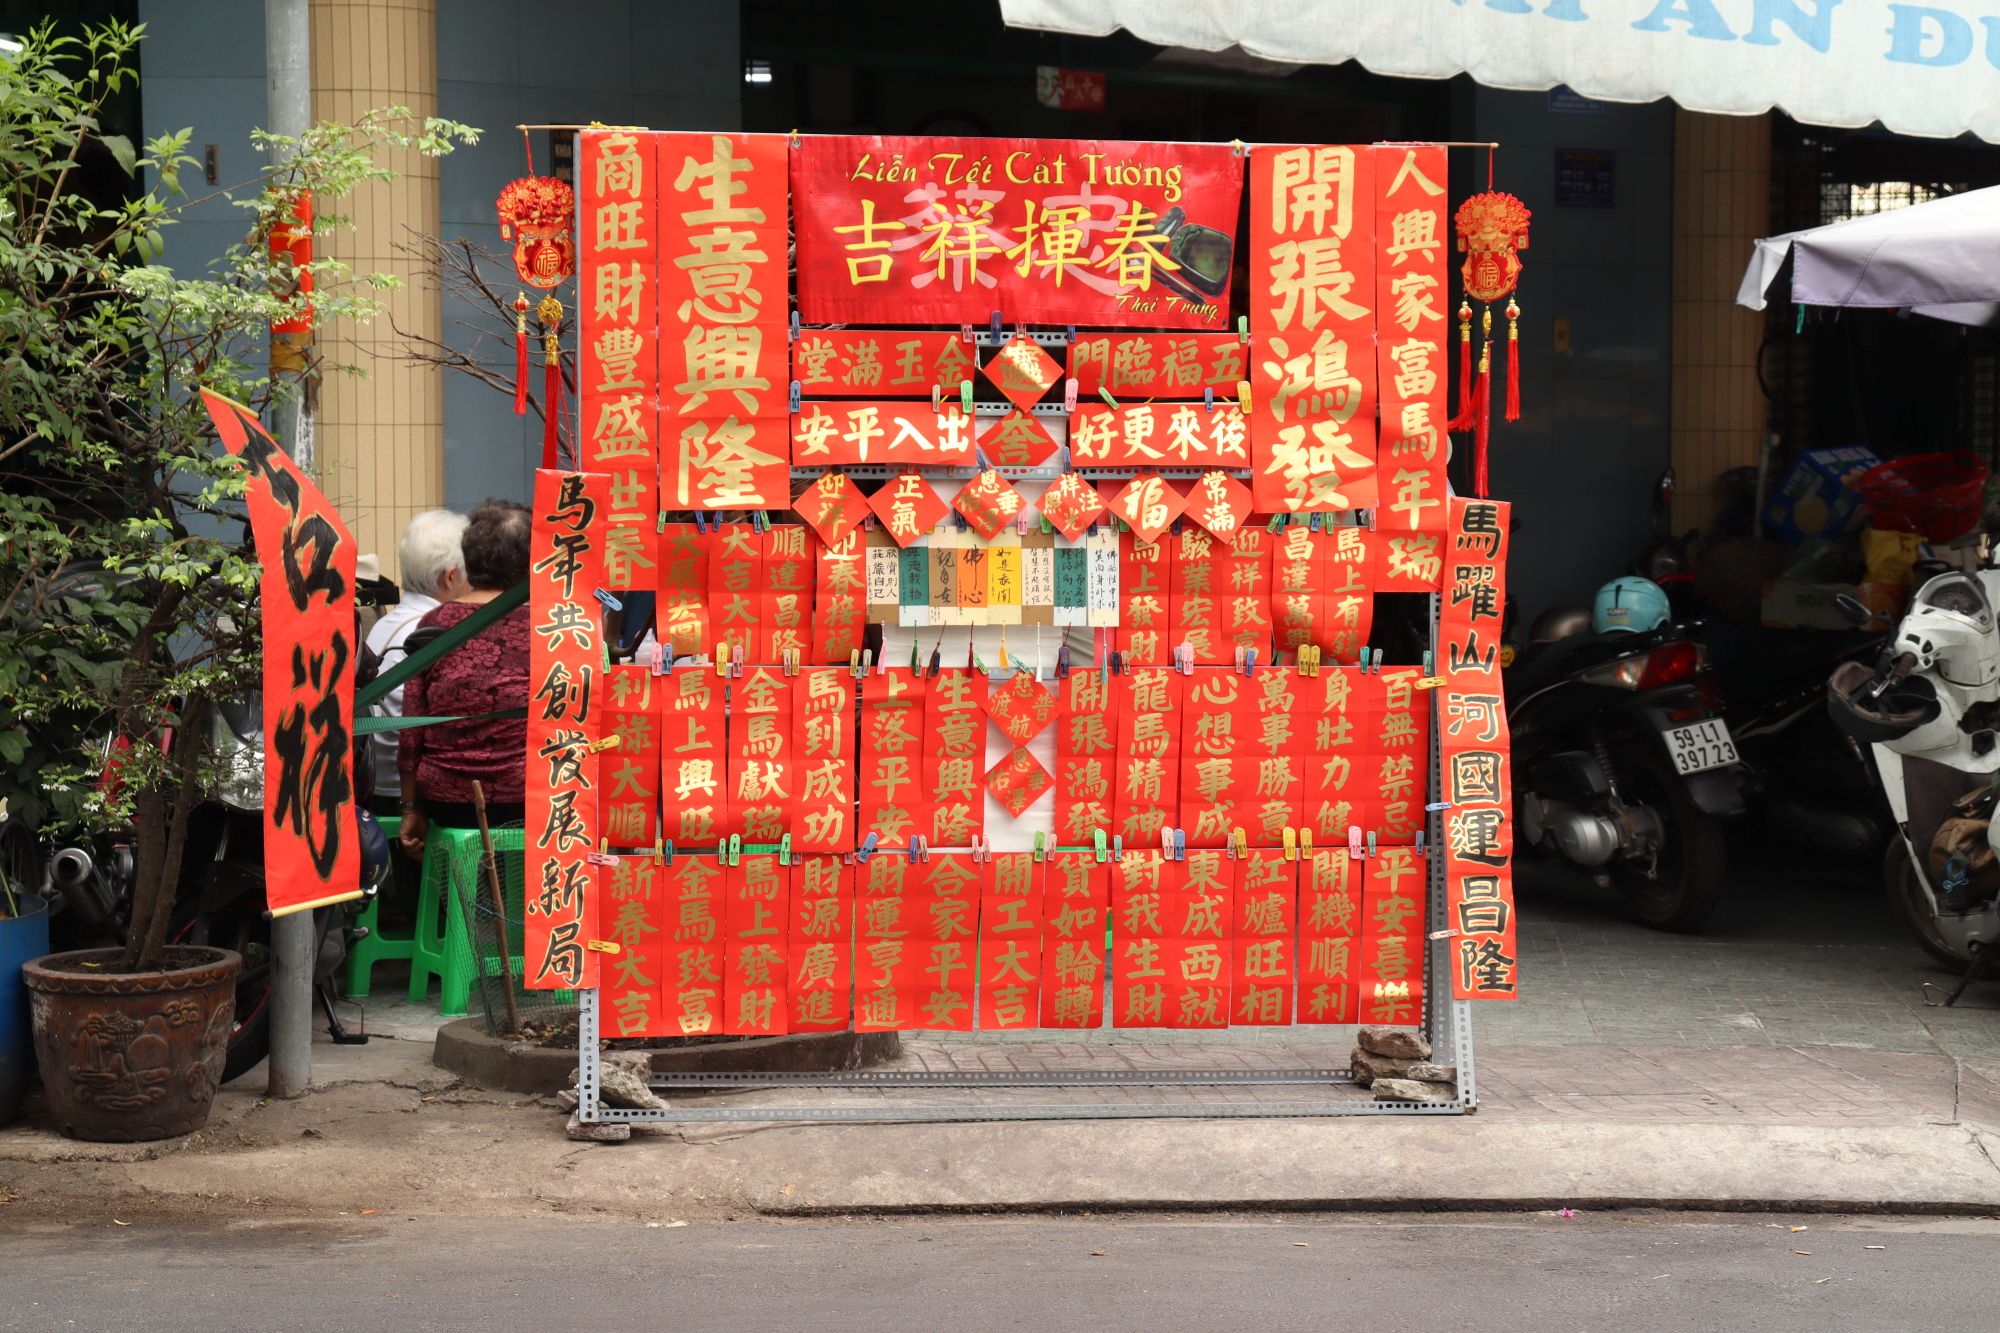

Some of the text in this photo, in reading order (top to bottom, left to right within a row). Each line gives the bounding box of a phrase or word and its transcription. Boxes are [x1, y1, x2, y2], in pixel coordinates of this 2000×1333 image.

[833, 199, 1182, 292] 吉祥揮春
[850, 151, 1184, 203] Liễn Tết Cát Tường
[672, 134, 786, 512] 生意興隆
[1263, 145, 1375, 513] 開張鴻發
[1384, 150, 1447, 582] 人興家富馬年瑞
[890, 474, 924, 537] 正氣
[1123, 476, 1168, 530] 福
[1202, 470, 1236, 532] 常滿
[721, 526, 760, 661] 大吉大利
[1126, 535, 1163, 663] 馬上發財
[606, 669, 653, 842] 利祿大順
[674, 669, 717, 841] 馬上興旺
[738, 668, 790, 841] 金馬獻瑞
[802, 669, 846, 847] 馬到成功
[869, 671, 919, 846] 上落平安
[932, 669, 982, 847] 生意興隆
[1063, 670, 1115, 843] 開張鴻發
[1121, 669, 1174, 846] 龍馬精神
[1191, 674, 1238, 845] 心想事成
[1256, 669, 1299, 843] 萬事勝意
[1314, 670, 1354, 841] 身壯力健
[1376, 671, 1419, 840] 百無禁忌
[1447, 502, 1515, 994] 馬躍山河國運昌隆
[1673, 722, 1720, 749] 59-L1
[1677, 742, 1736, 771] 397.23
[609, 856, 660, 1037] 新春大吉
[672, 856, 721, 1034] 金馬致富
[736, 856, 784, 1030] 馬上發財
[796, 856, 844, 1026] 財源廣進
[861, 857, 910, 1028] 財運亨通
[922, 854, 978, 1027] 合家平安
[991, 852, 1036, 1028] 開工大吉
[1050, 854, 1103, 1029] 貨如輪轉
[1120, 850, 1166, 1024] 對我生財
[1176, 850, 1228, 1026] 東成西就
[1241, 852, 1289, 1023] 紅爐旺相
[1308, 851, 1356, 1022] 開機順利
[1370, 848, 1418, 1023] 平安喜樂
